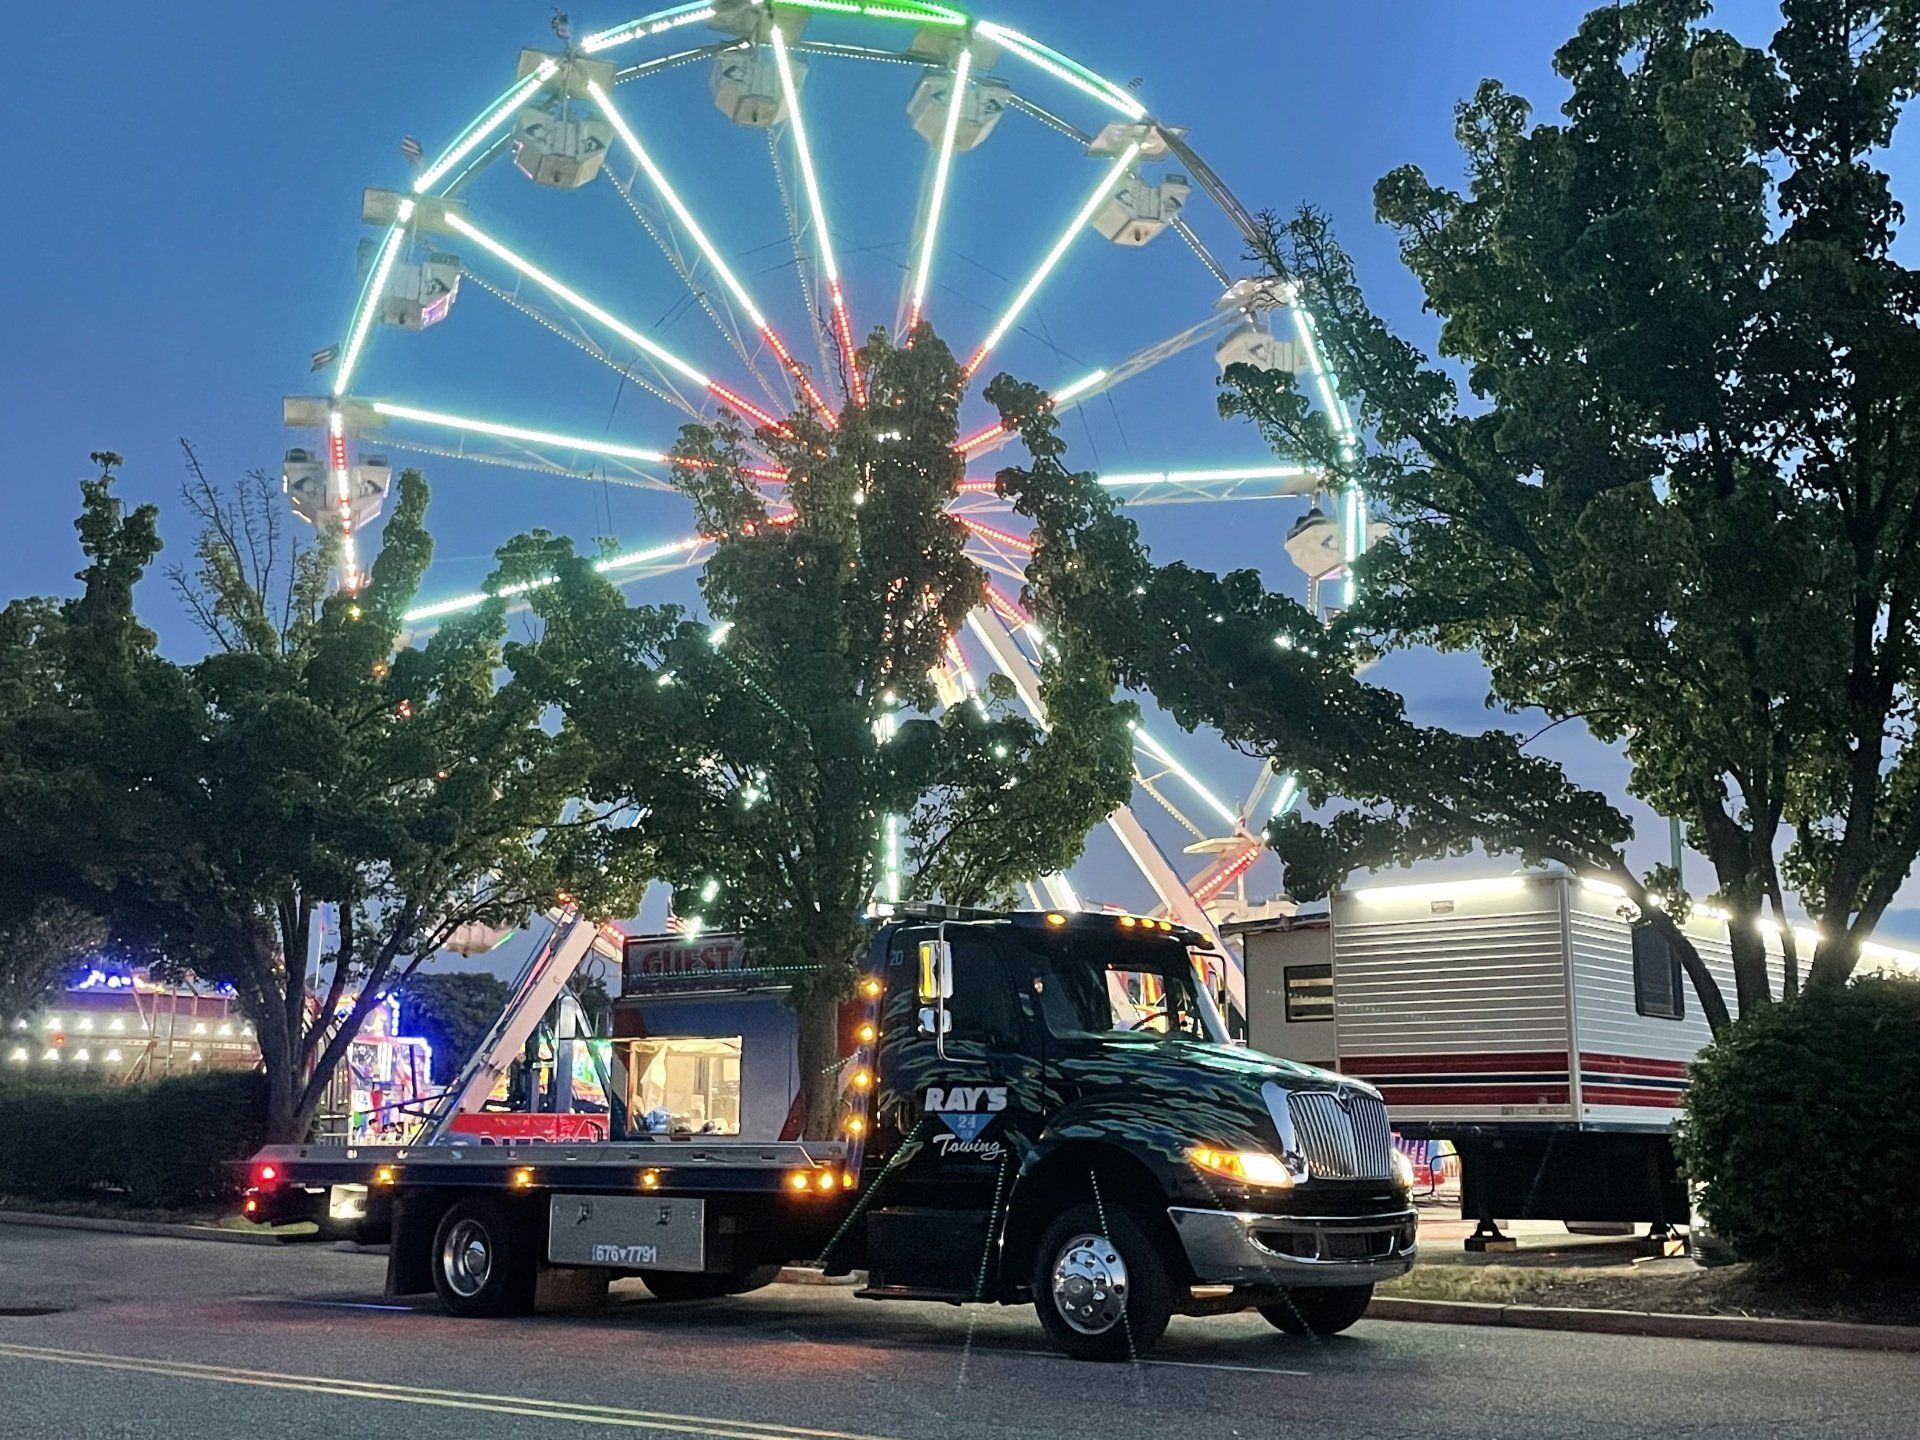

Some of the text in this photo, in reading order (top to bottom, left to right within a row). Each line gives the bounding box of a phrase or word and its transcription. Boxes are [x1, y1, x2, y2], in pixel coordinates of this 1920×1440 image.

[642, 946, 733, 980] GUEST
[957, 1115, 977, 1129] 24
[932, 1133, 1007, 1161] Towing
